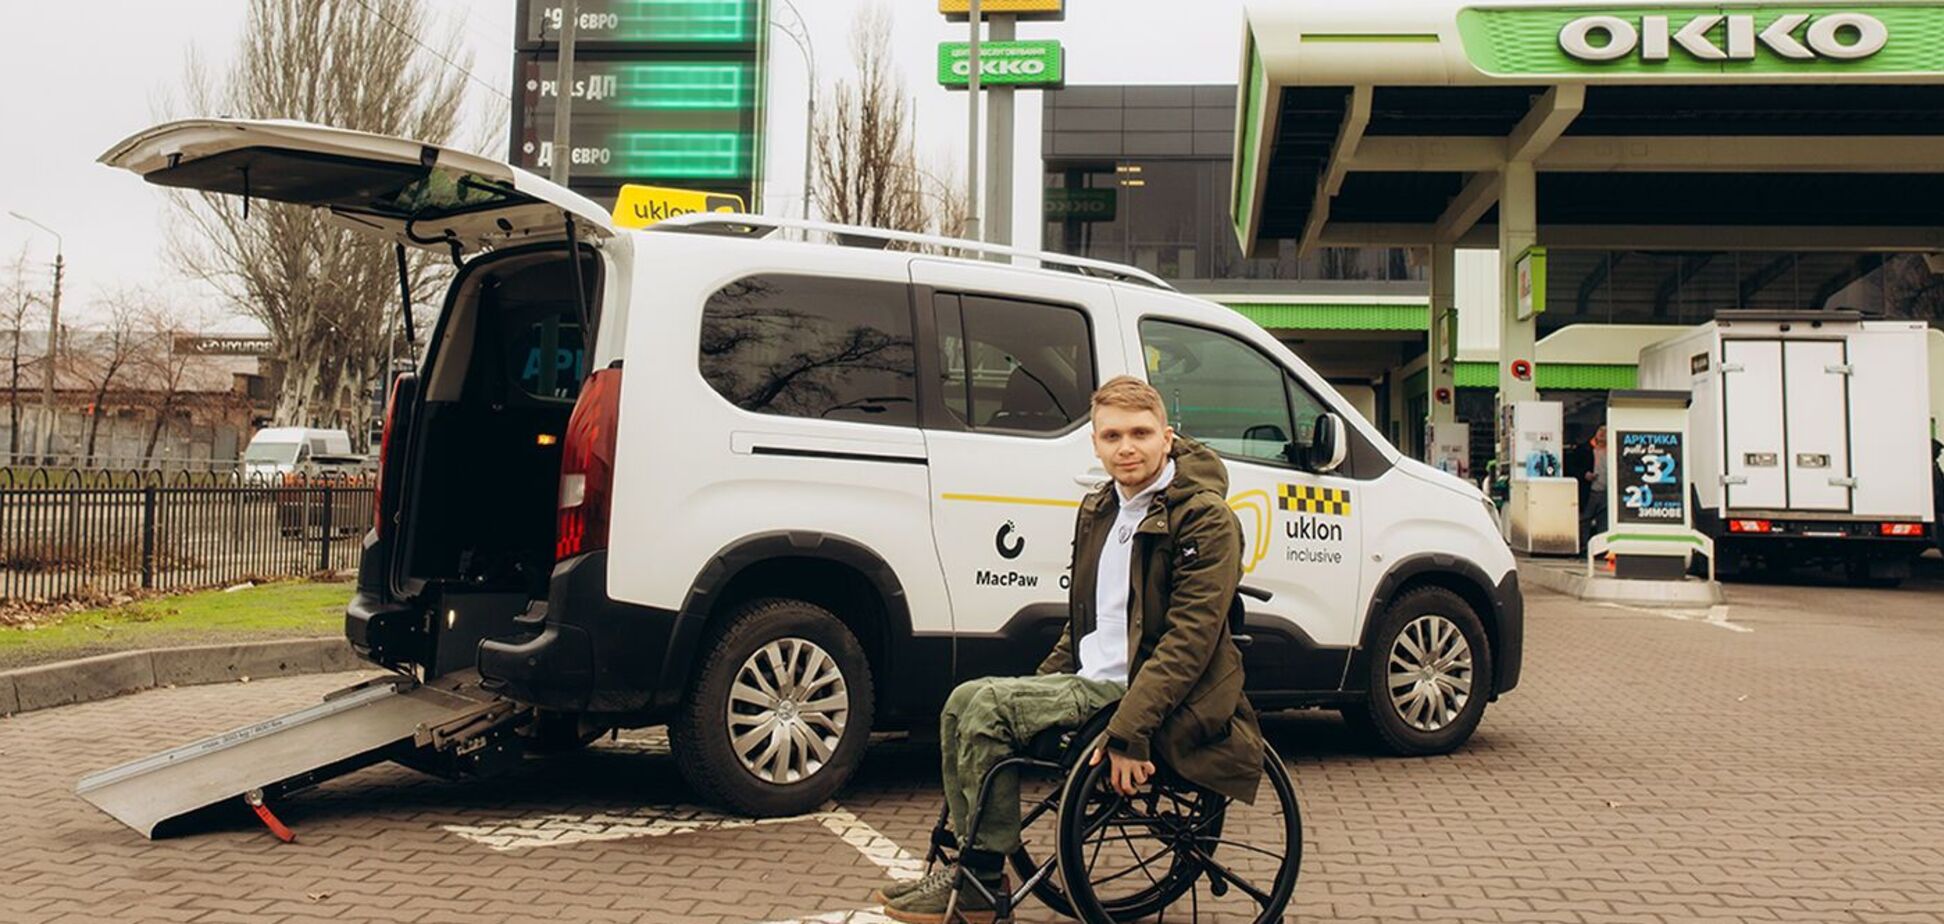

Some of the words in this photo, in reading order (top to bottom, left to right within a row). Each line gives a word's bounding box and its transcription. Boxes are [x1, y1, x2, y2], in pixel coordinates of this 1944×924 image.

[579, 13, 618, 30] ЄВРО
[1557, 11, 1889, 61] OKKO
[951, 60, 1045, 76] OKKO
[586, 75, 616, 100] ДП
[571, 147, 611, 165] ЄВРО
[1623, 434, 1678, 446] АРКТИКА
[1638, 507, 1682, 518] ЗИМОВЕ
[1286, 515, 1343, 541] uklon
[1286, 545, 1343, 564] inclusive
[976, 570, 1039, 587] MacPaw
